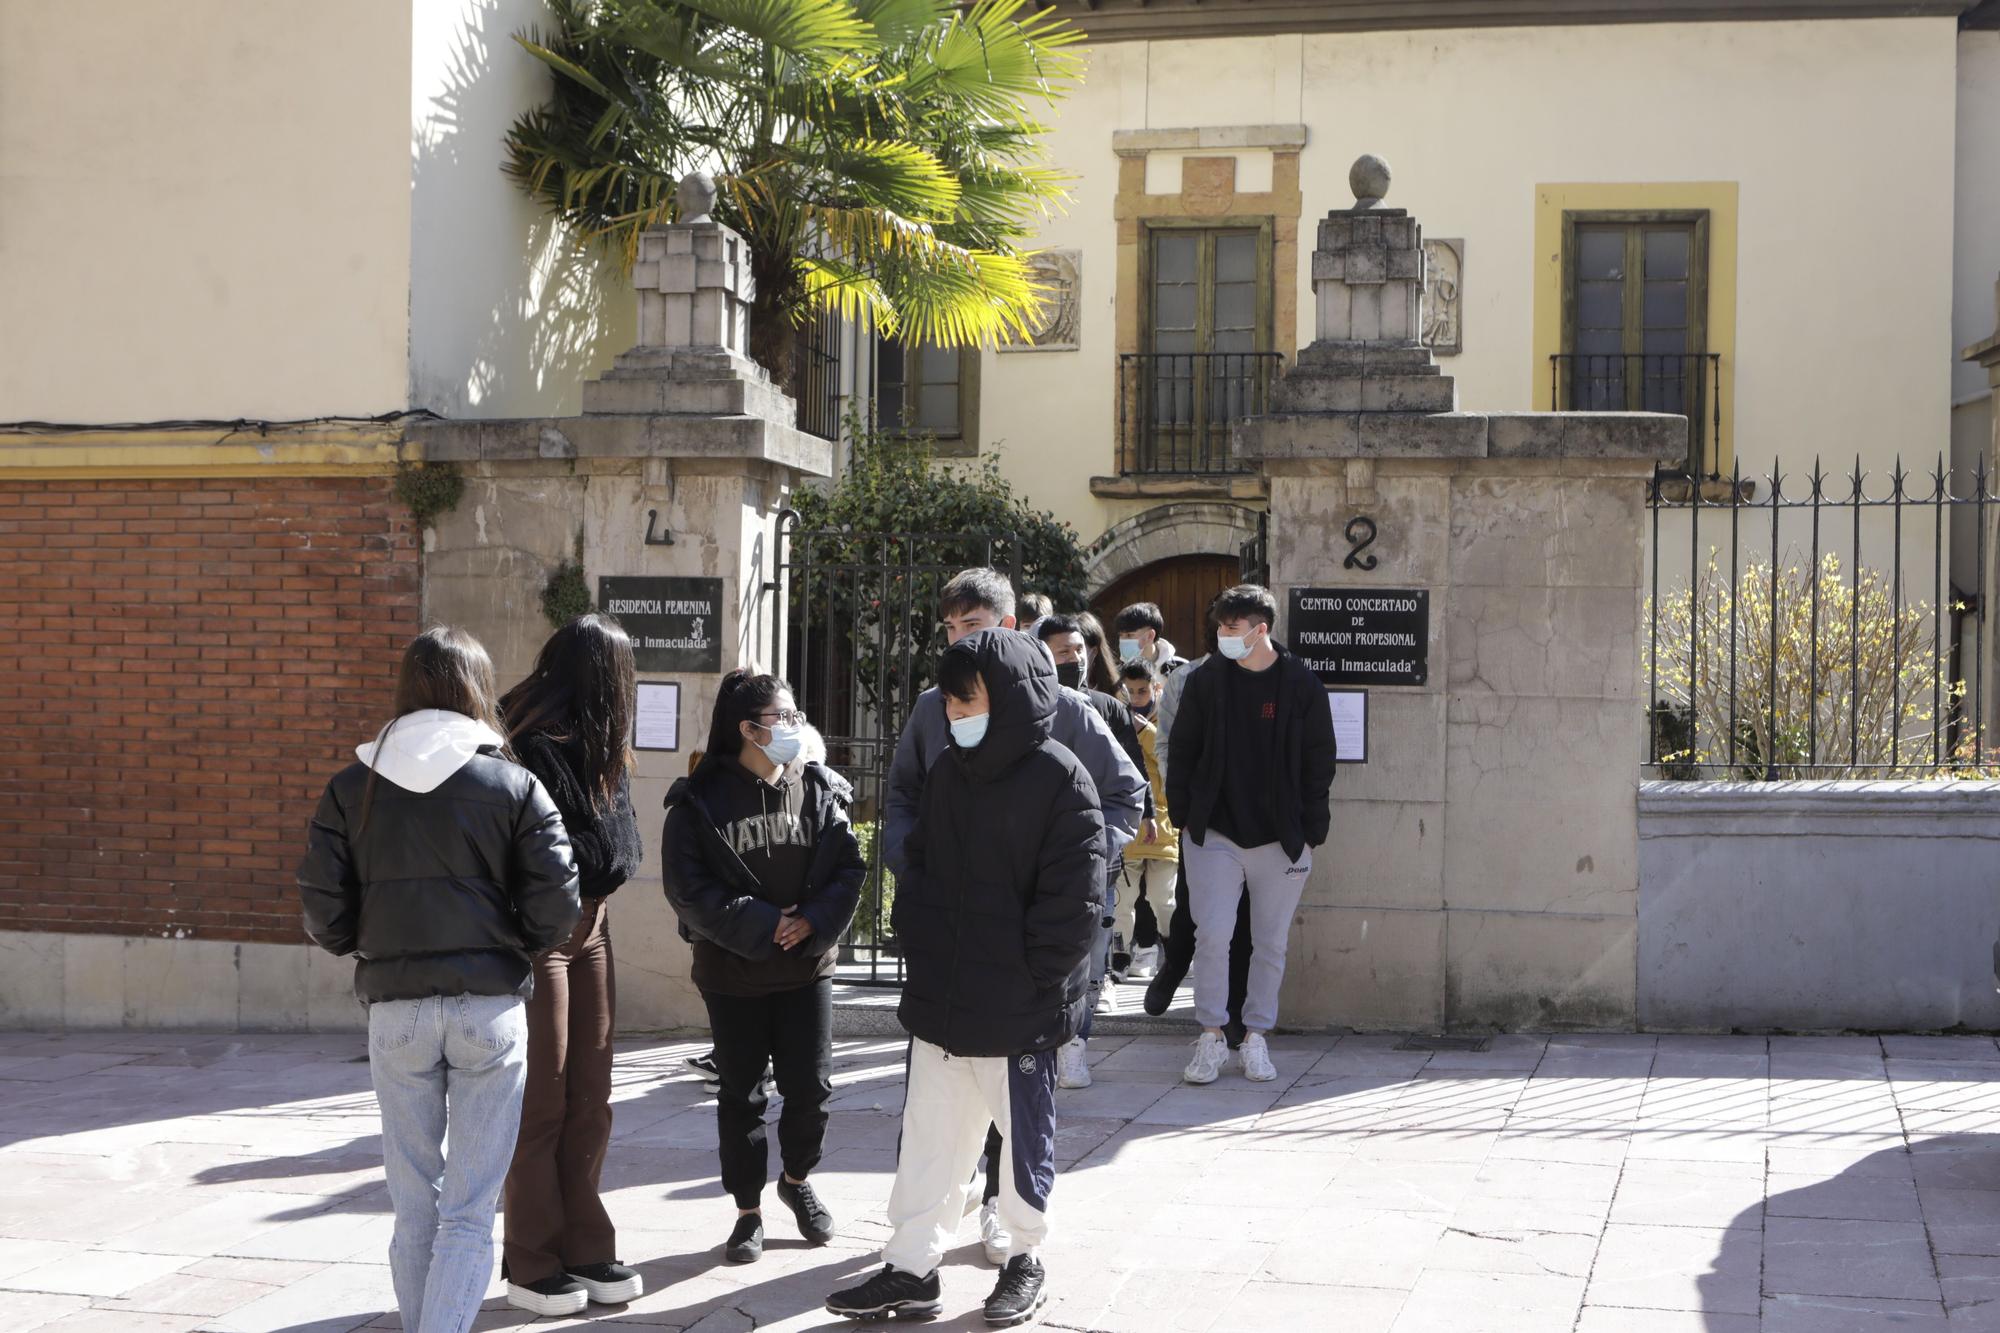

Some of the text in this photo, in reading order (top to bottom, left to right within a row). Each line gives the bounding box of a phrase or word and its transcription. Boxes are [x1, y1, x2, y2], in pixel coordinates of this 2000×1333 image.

[1344, 516, 1377, 571] 2
[609, 599, 711, 616] RESIDENCIA FEMENINA
[1300, 597, 1417, 612] CENTRO CONCERTADO
[1351, 617, 1365, 626] DE
[1299, 631, 1416, 646] FORMACION PROFESIONAL
[1341, 658, 1416, 673] Inmaculada"
